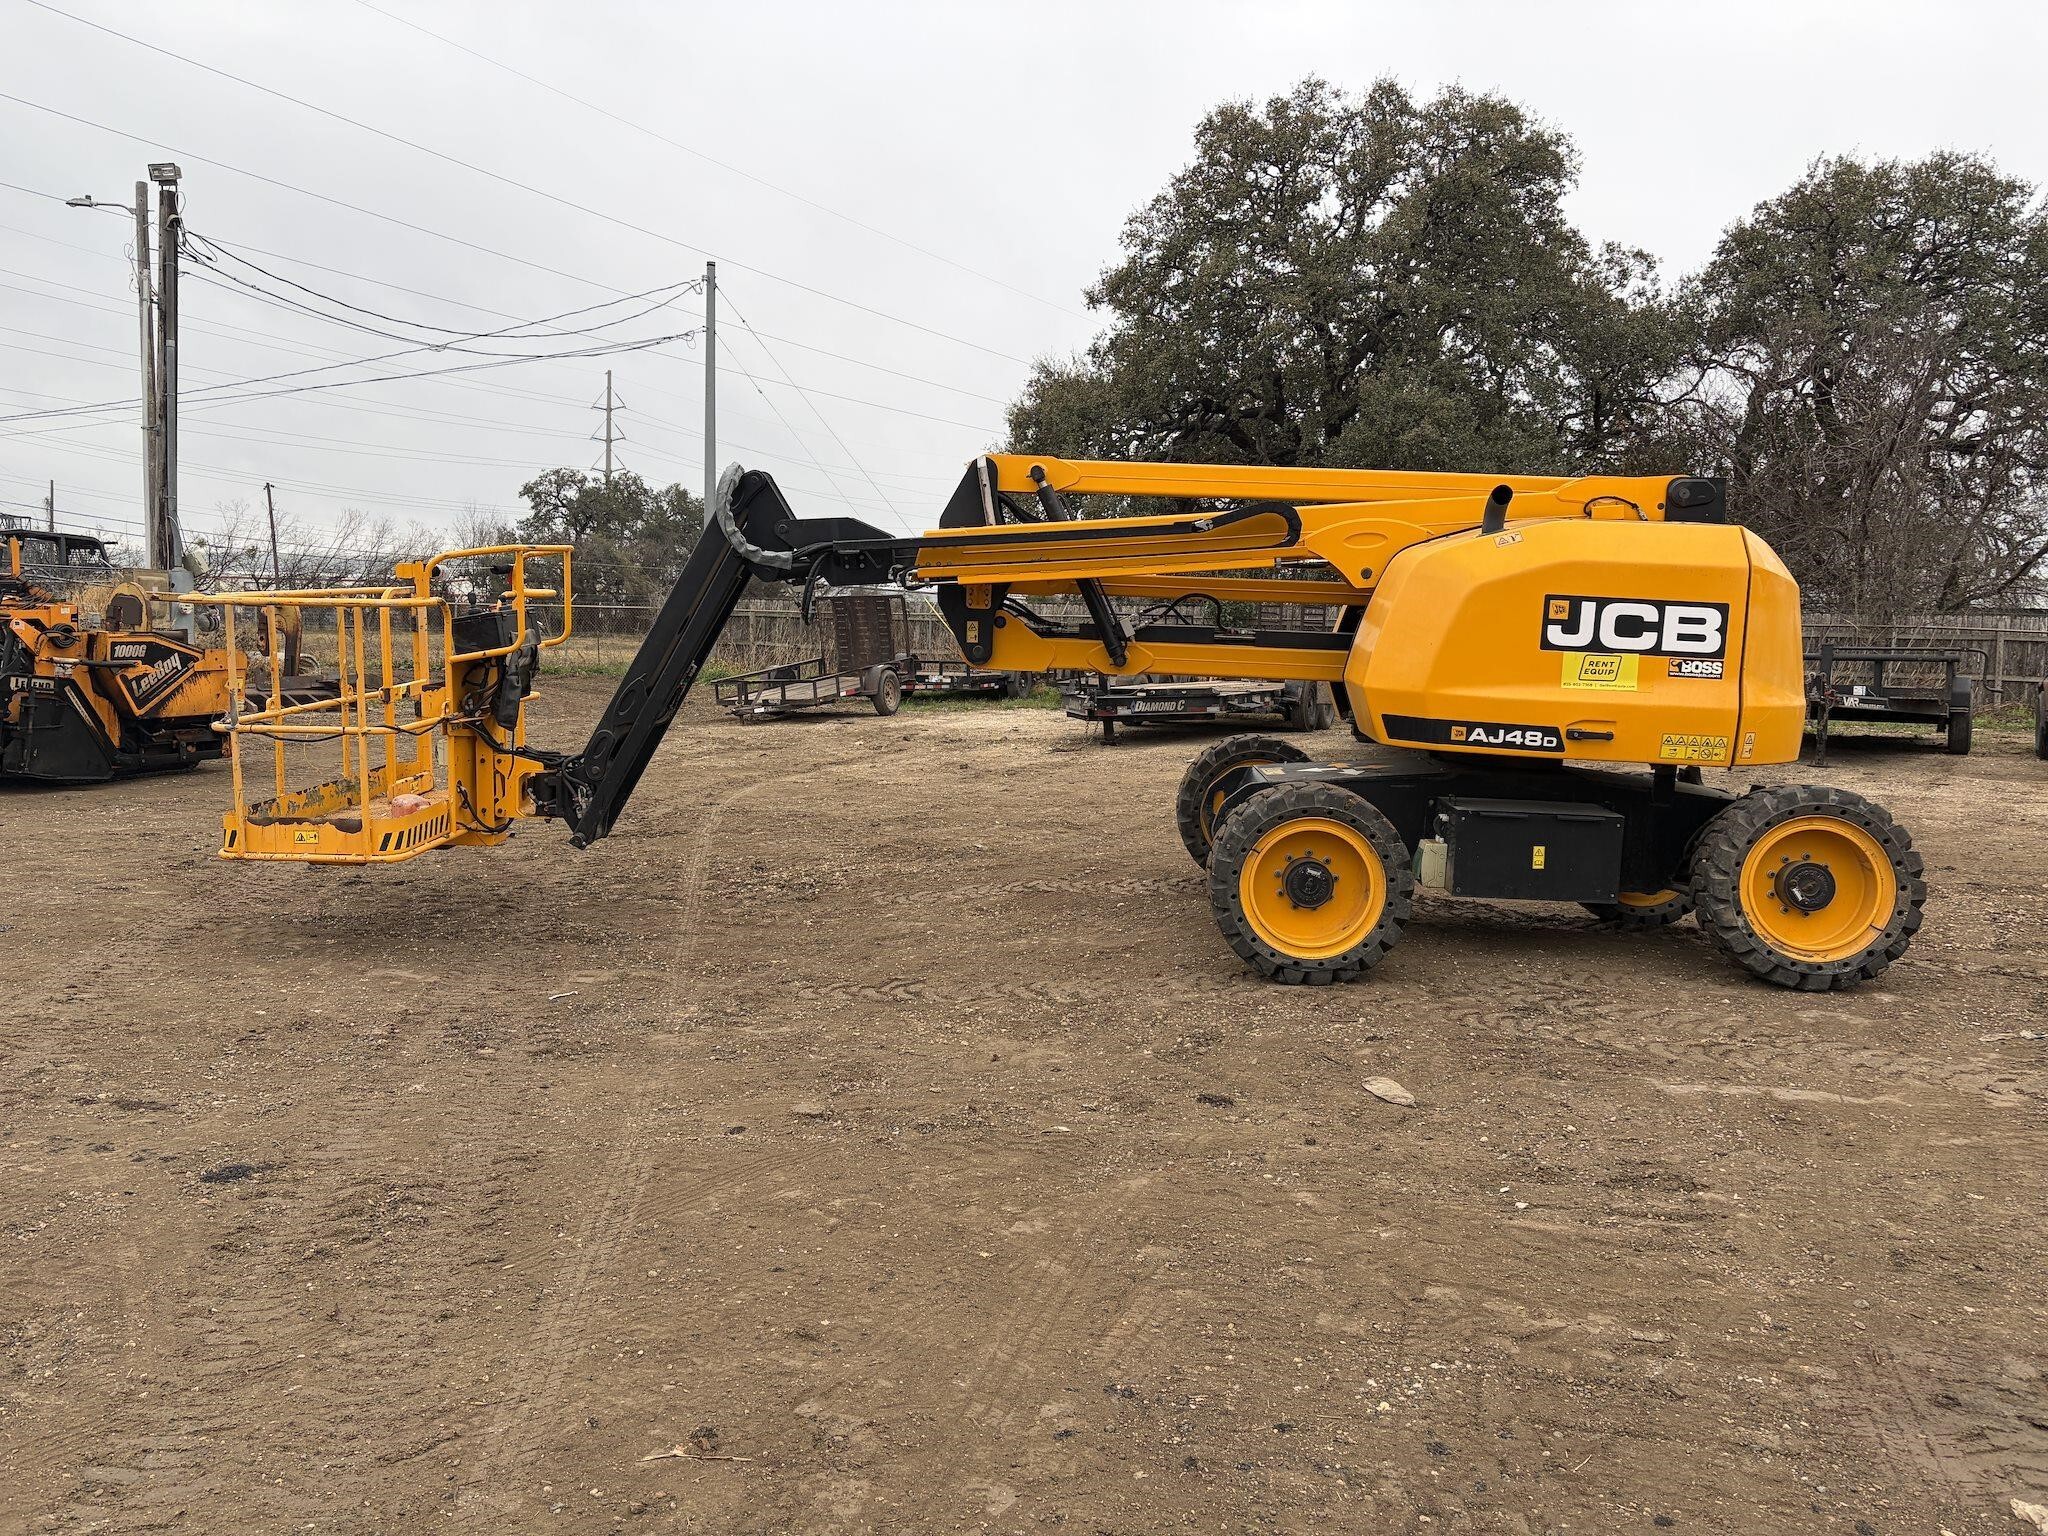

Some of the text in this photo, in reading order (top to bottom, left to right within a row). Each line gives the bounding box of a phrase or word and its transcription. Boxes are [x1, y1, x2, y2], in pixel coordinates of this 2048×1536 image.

[1547, 601, 1722, 654] JCB
[113, 644, 147, 658] 1000G
[1588, 660, 1615, 668] RENT
[1681, 660, 1723, 674] BOSS
[131, 652, 182, 698] LeeBoy
[1584, 668, 1615, 676] EQUIP
[1134, 699, 1186, 713] DIAMOND C
[1467, 727, 1558, 748] AJ48D
